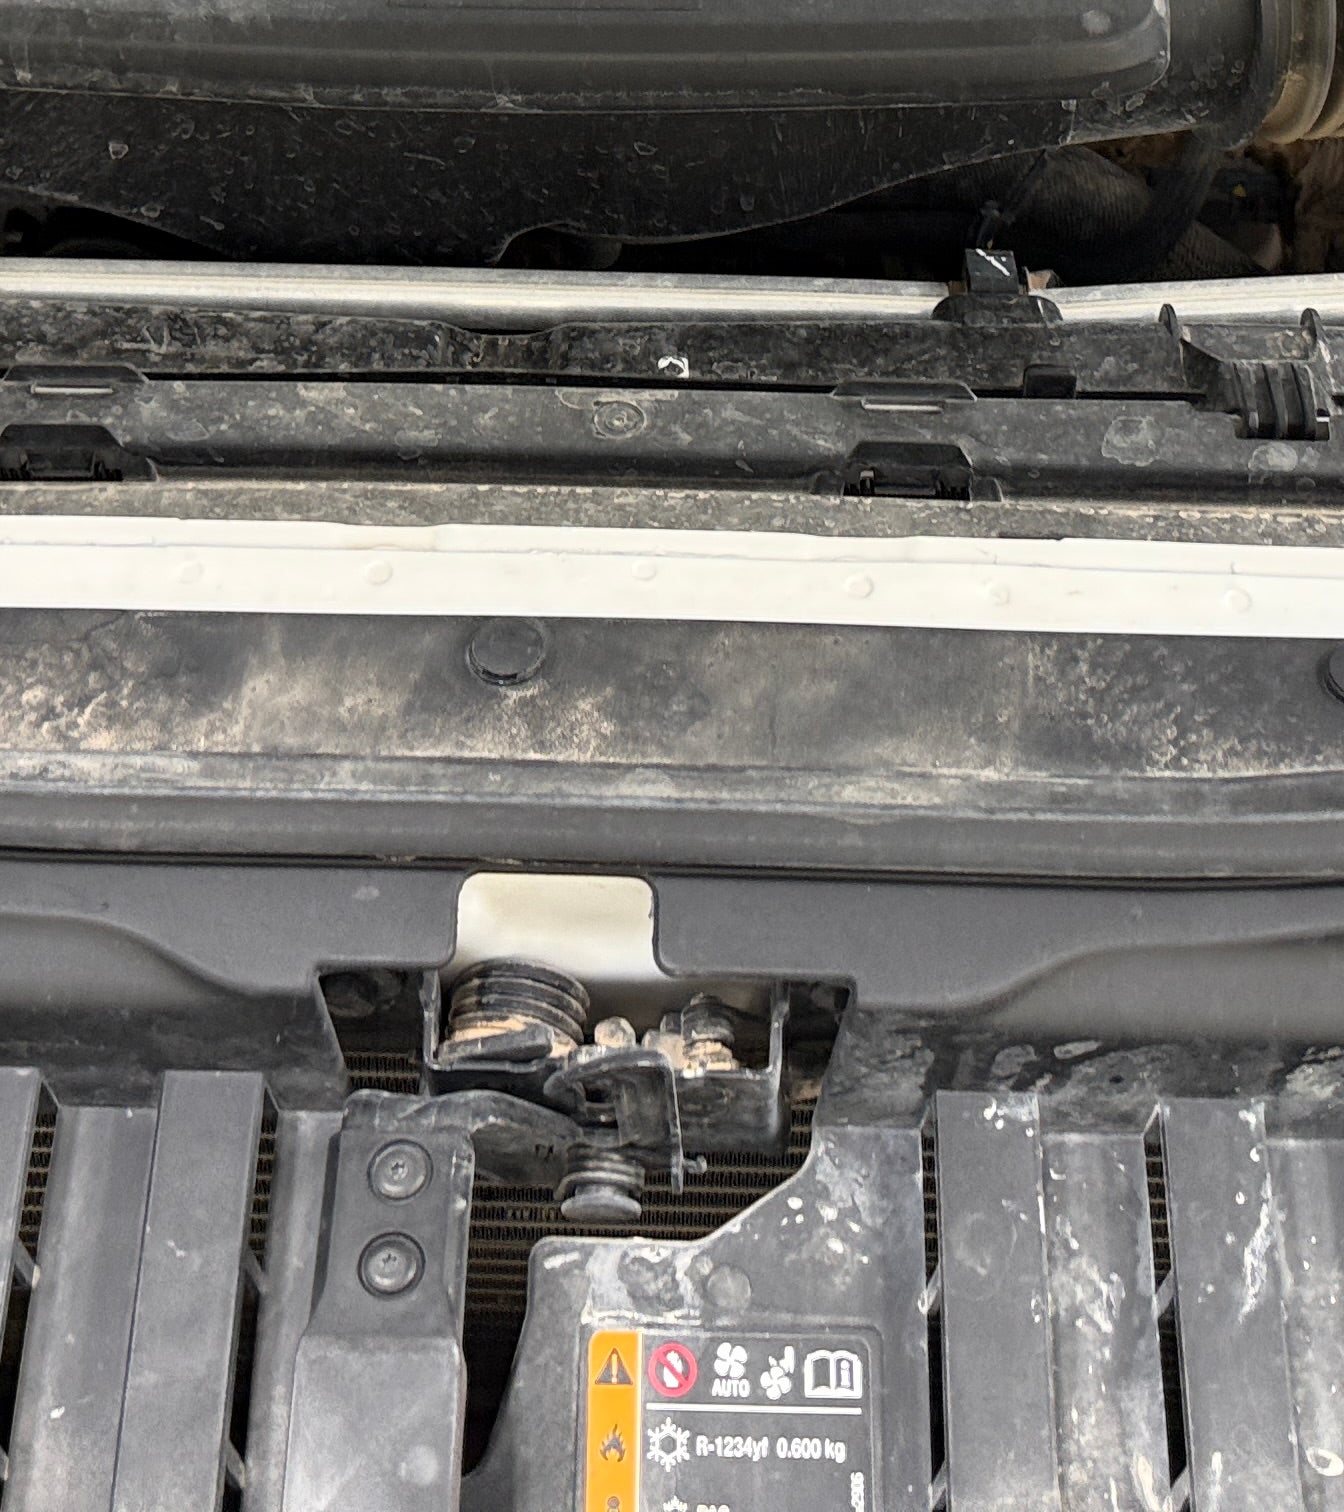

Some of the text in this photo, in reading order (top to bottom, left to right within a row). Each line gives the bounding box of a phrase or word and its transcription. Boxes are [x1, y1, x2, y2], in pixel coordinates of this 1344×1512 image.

[711, 1379, 750, 1398] AUTO
[695, 1435, 847, 1463] R-1234yf 0.600 kg
